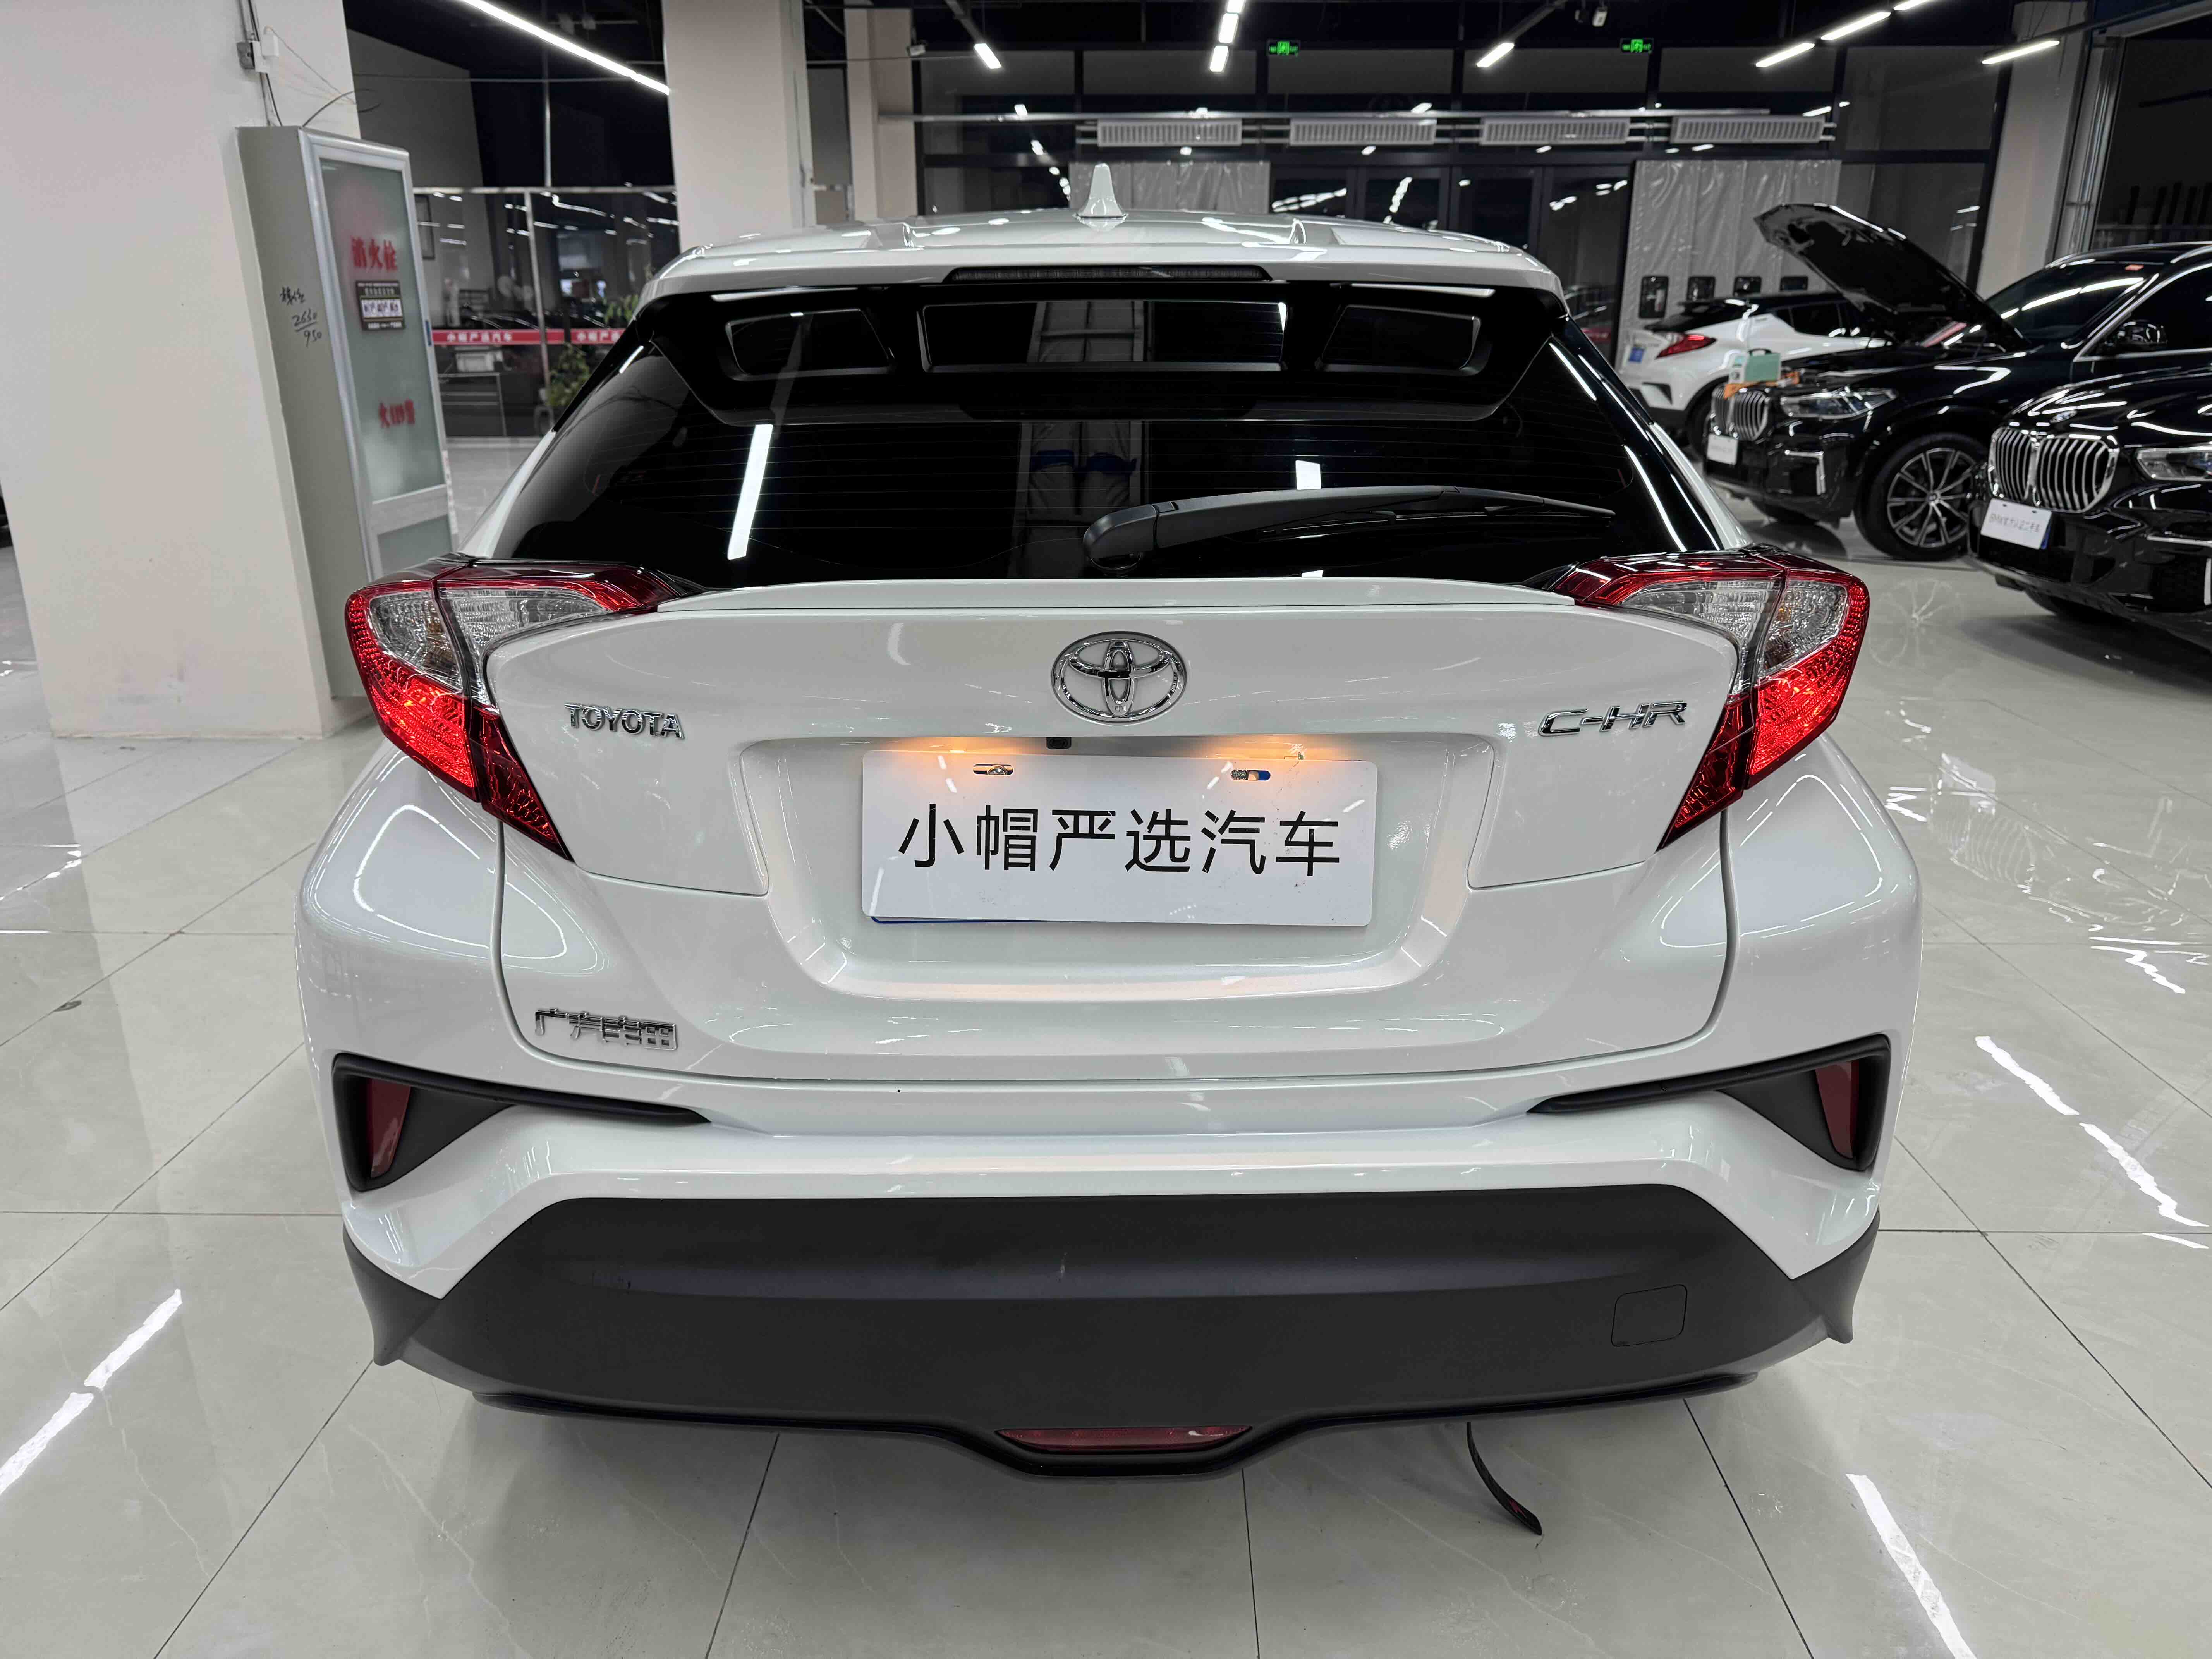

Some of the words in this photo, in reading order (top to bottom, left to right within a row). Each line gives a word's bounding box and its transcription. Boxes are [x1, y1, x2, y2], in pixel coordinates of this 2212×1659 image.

[564, 703, 685, 739] TOYOTA
[1538, 700, 1688, 736] C-HR
[898, 803, 1340, 876] 小帽严选汽车
